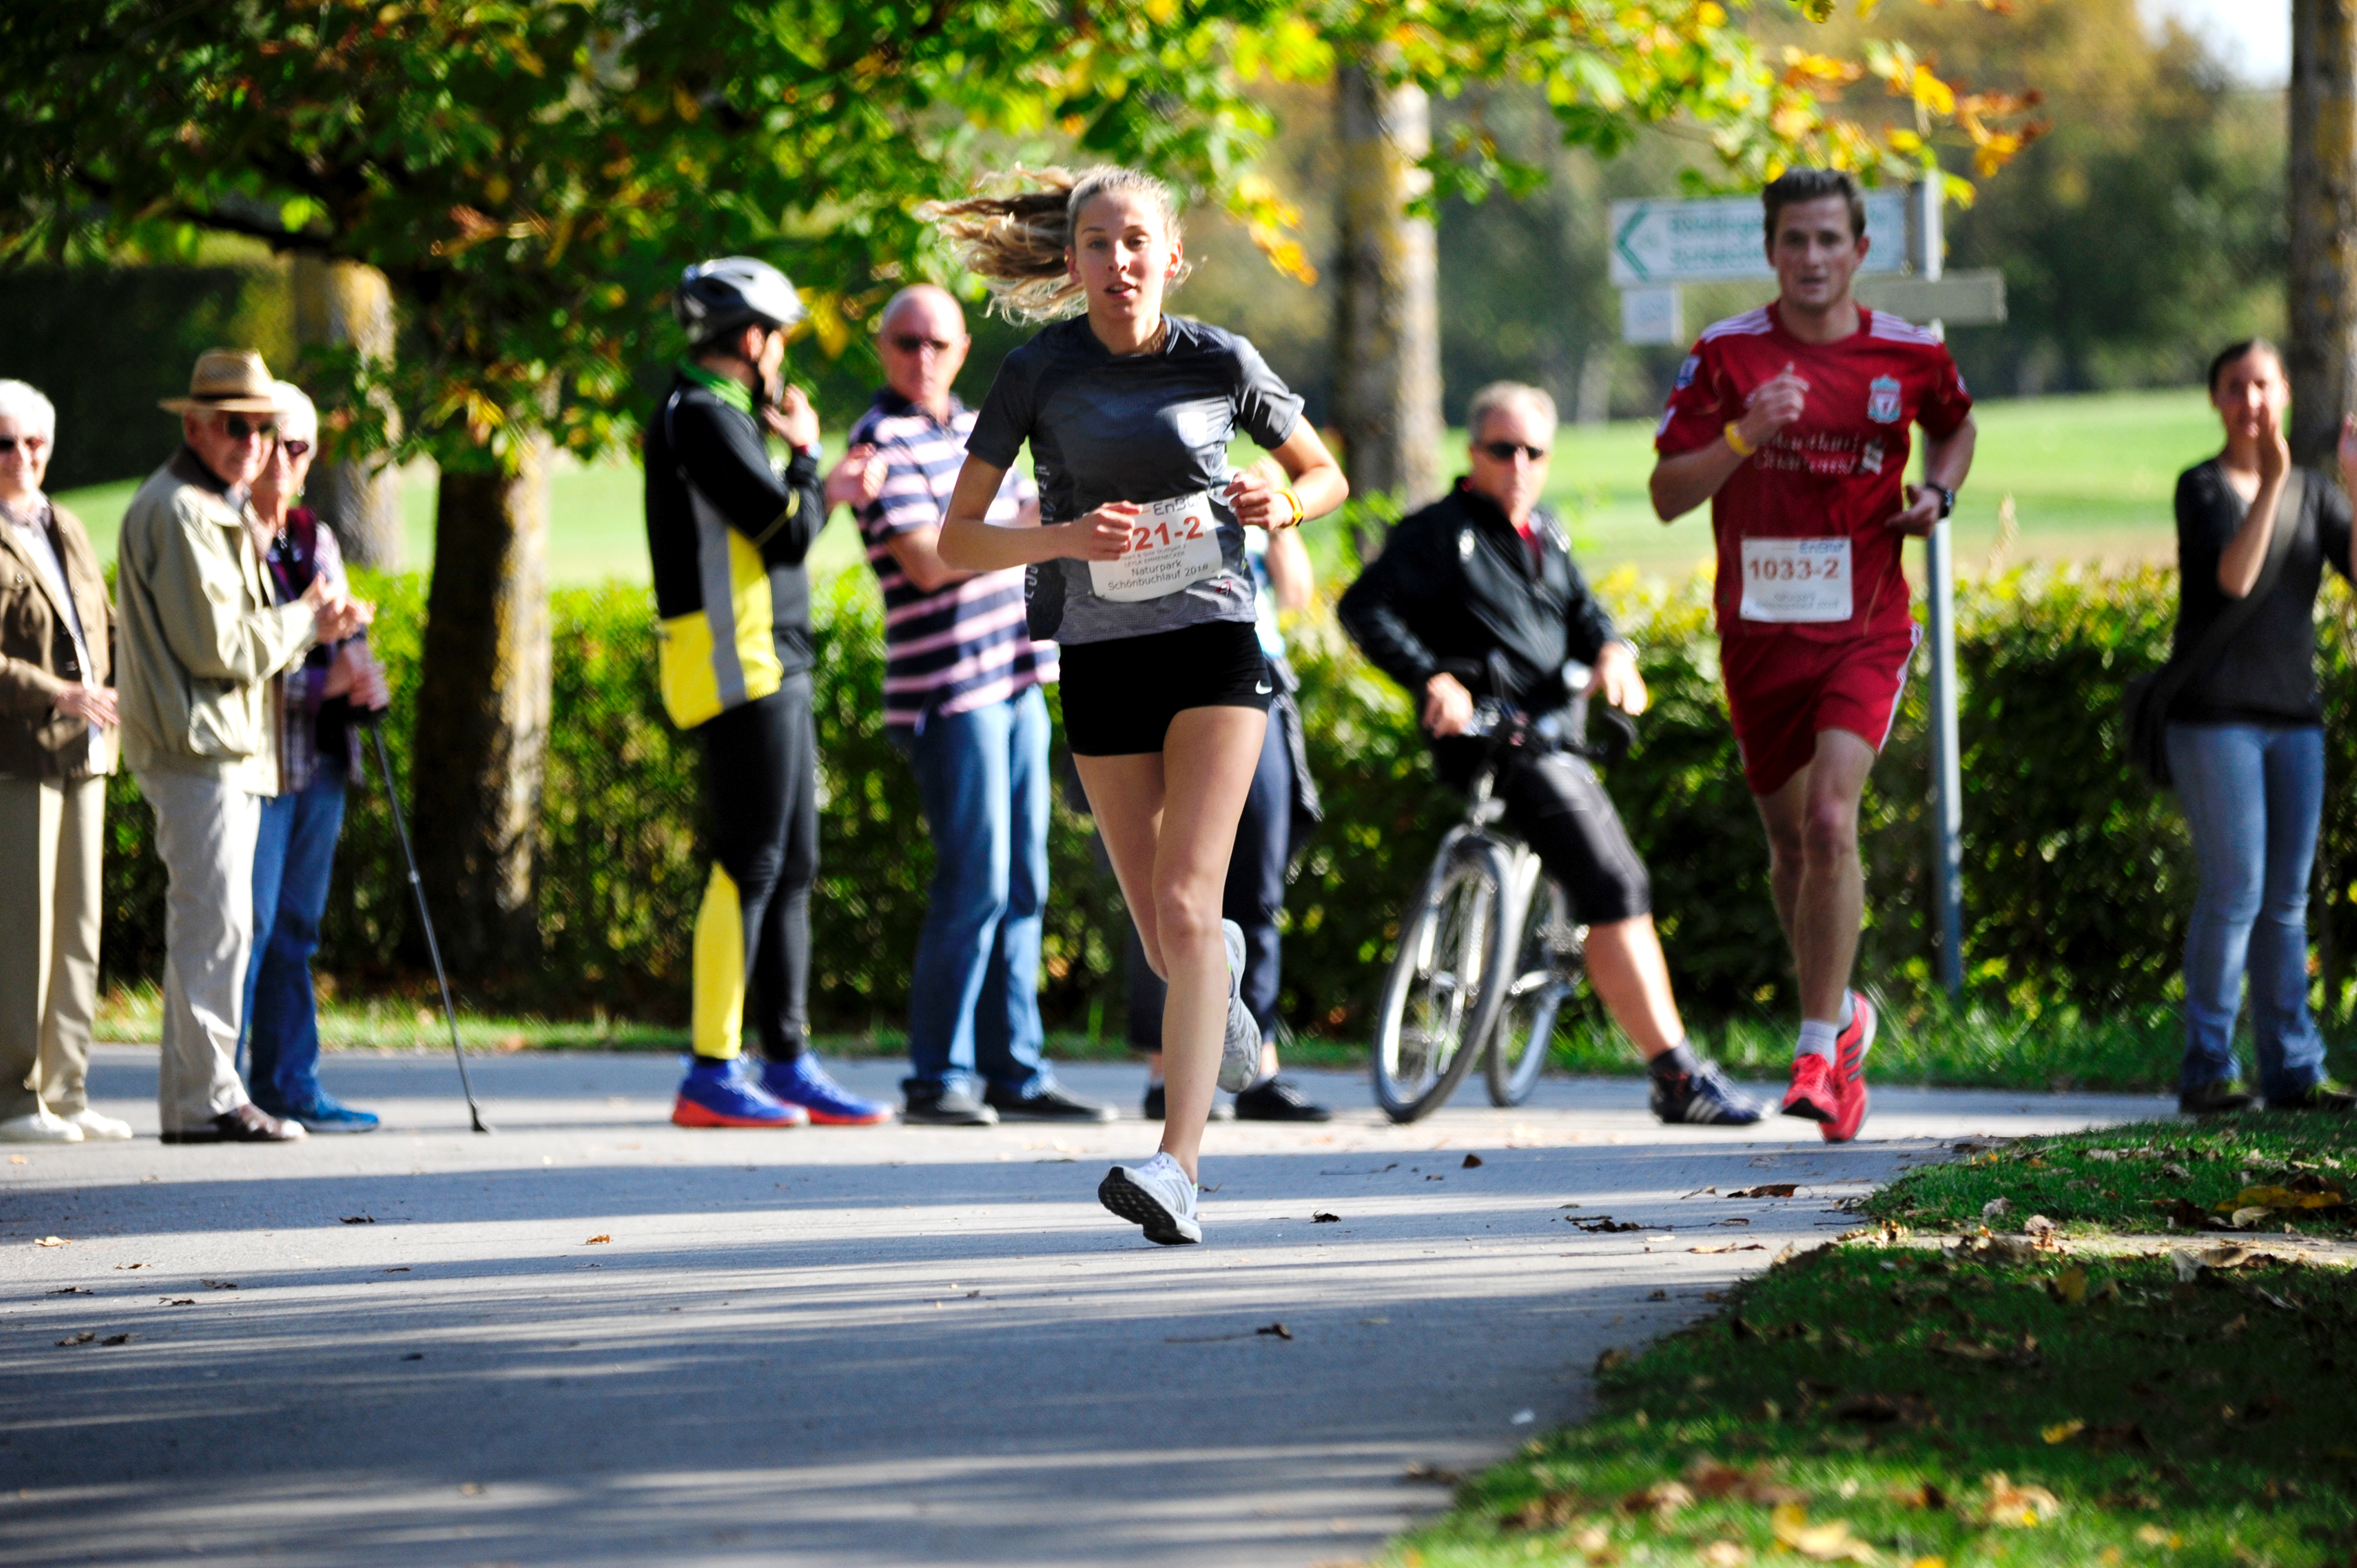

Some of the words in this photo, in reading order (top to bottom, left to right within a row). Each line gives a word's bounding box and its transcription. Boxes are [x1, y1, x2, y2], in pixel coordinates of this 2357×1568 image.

[1108, 570, 1181, 591] Schönbuchlauf
[1184, 563, 1208, 577] 2018
[1131, 560, 1182, 576] Naturpark
[1749, 556, 1840, 580] 1033-2
